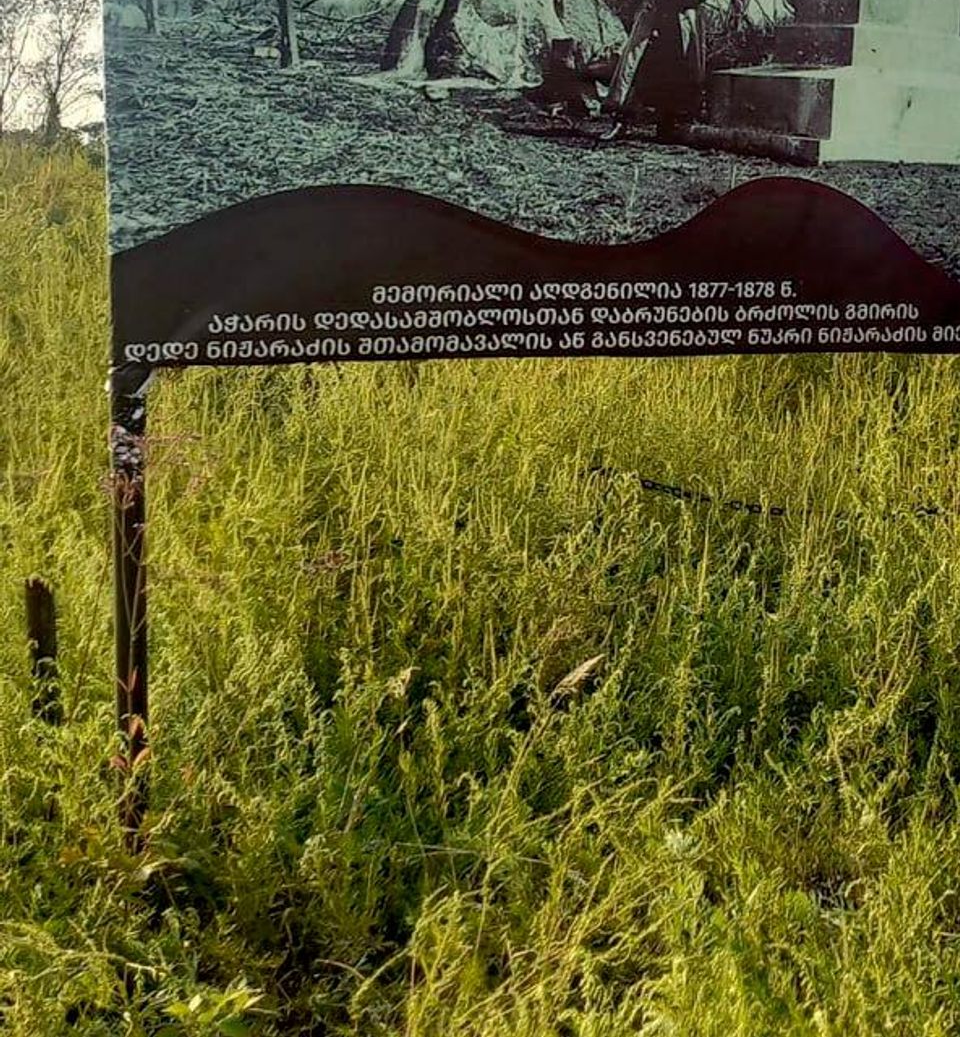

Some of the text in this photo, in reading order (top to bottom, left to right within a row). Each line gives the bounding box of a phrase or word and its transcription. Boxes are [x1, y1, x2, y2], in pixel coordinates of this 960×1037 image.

[372, 280, 798, 304] მემორიალი აღდგენილია 1877-1878 წ.
[208, 302, 920, 335] აჭარის დედასამშობლოსთან დაბრუნების ბრძოლის გმირის
[124, 341, 199, 364] დედე
[206, 337, 351, 359] ნიჟარაძის
[357, 332, 552, 356] შთამომავალის
[591, 328, 743, 350] განსვენებულ
[748, 327, 813, 346] ნუკრი
[818, 325, 928, 345] ნიჟარაძის
